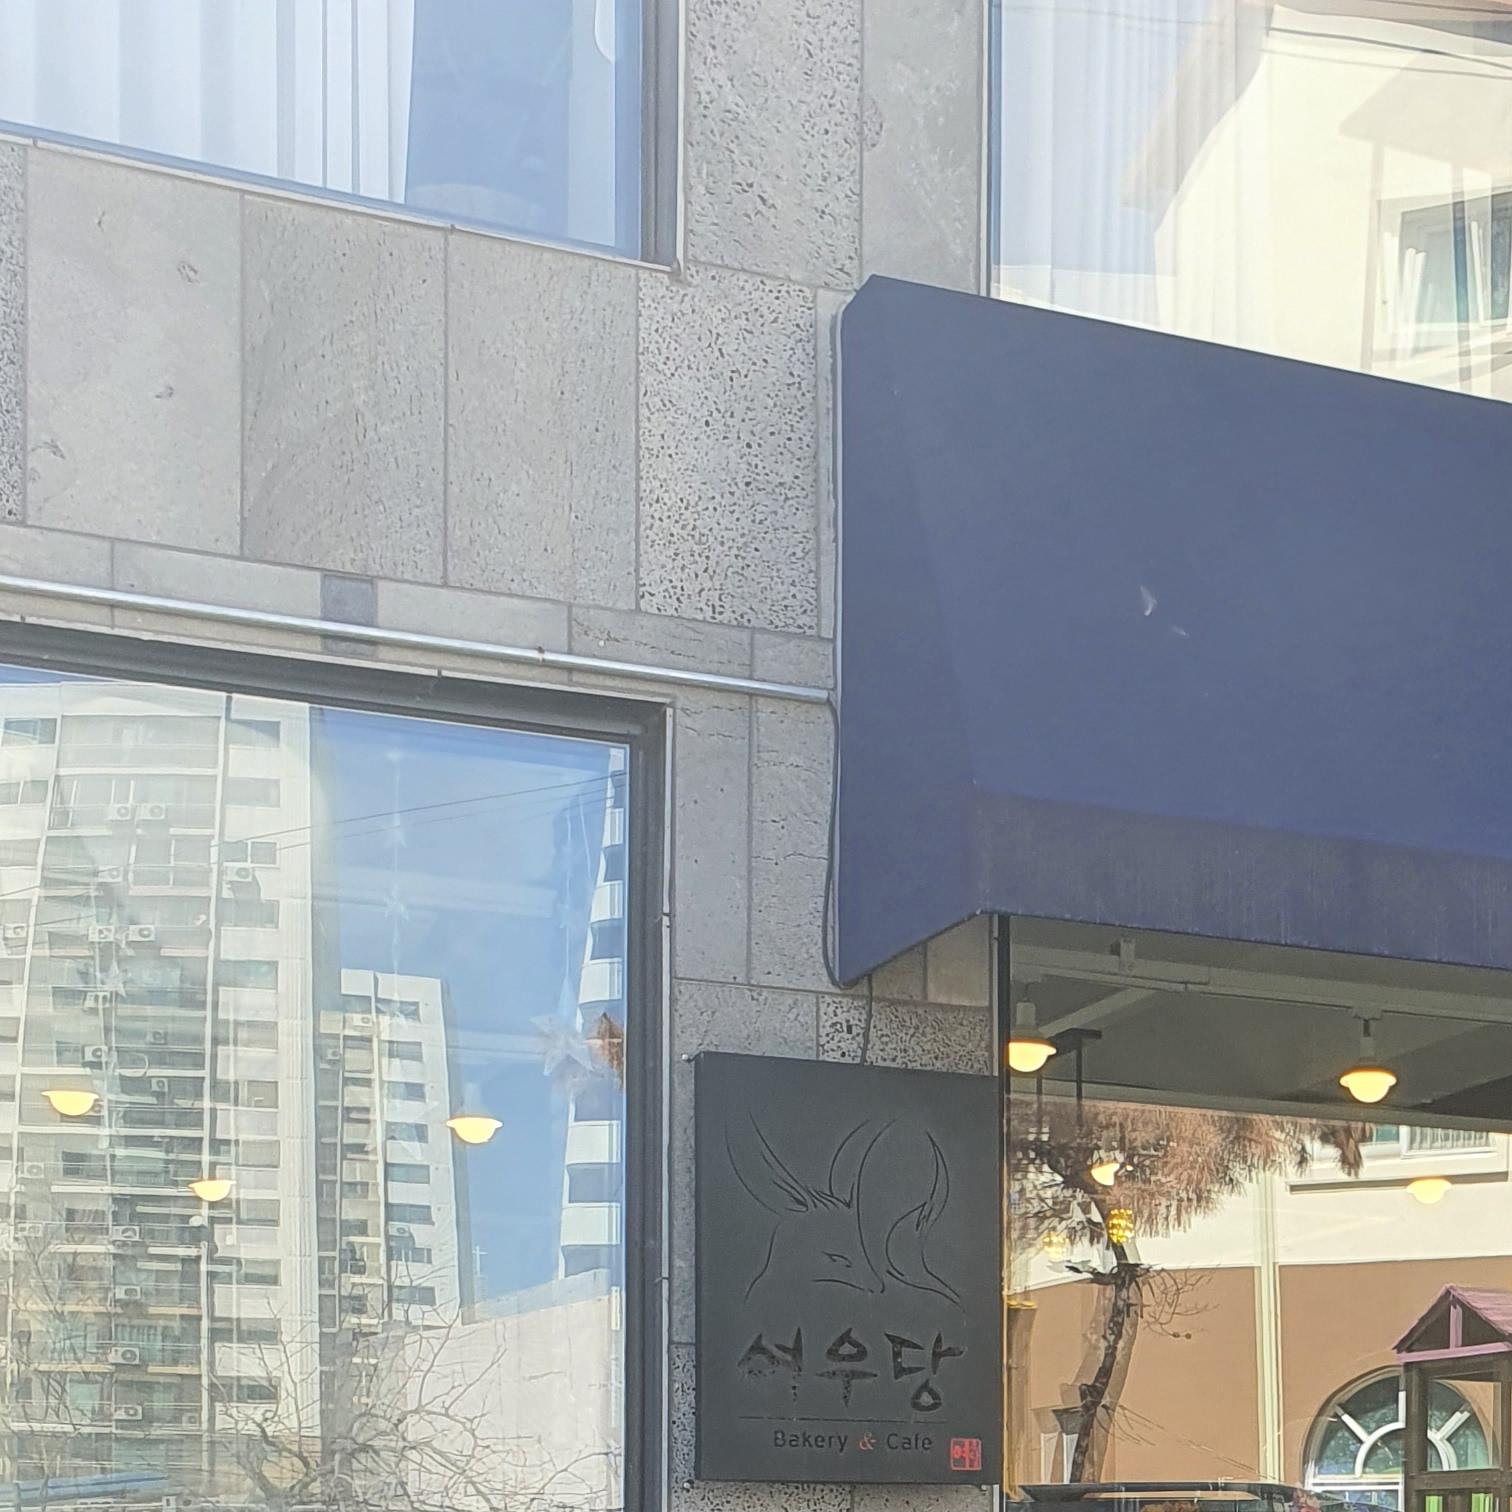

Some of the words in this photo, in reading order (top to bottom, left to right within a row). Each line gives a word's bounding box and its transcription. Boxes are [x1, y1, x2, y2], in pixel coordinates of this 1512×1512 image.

[774, 1429, 848, 1453] Bakery
[859, 1431, 876, 1450] &
[886, 1431, 933, 1450] Cafe
